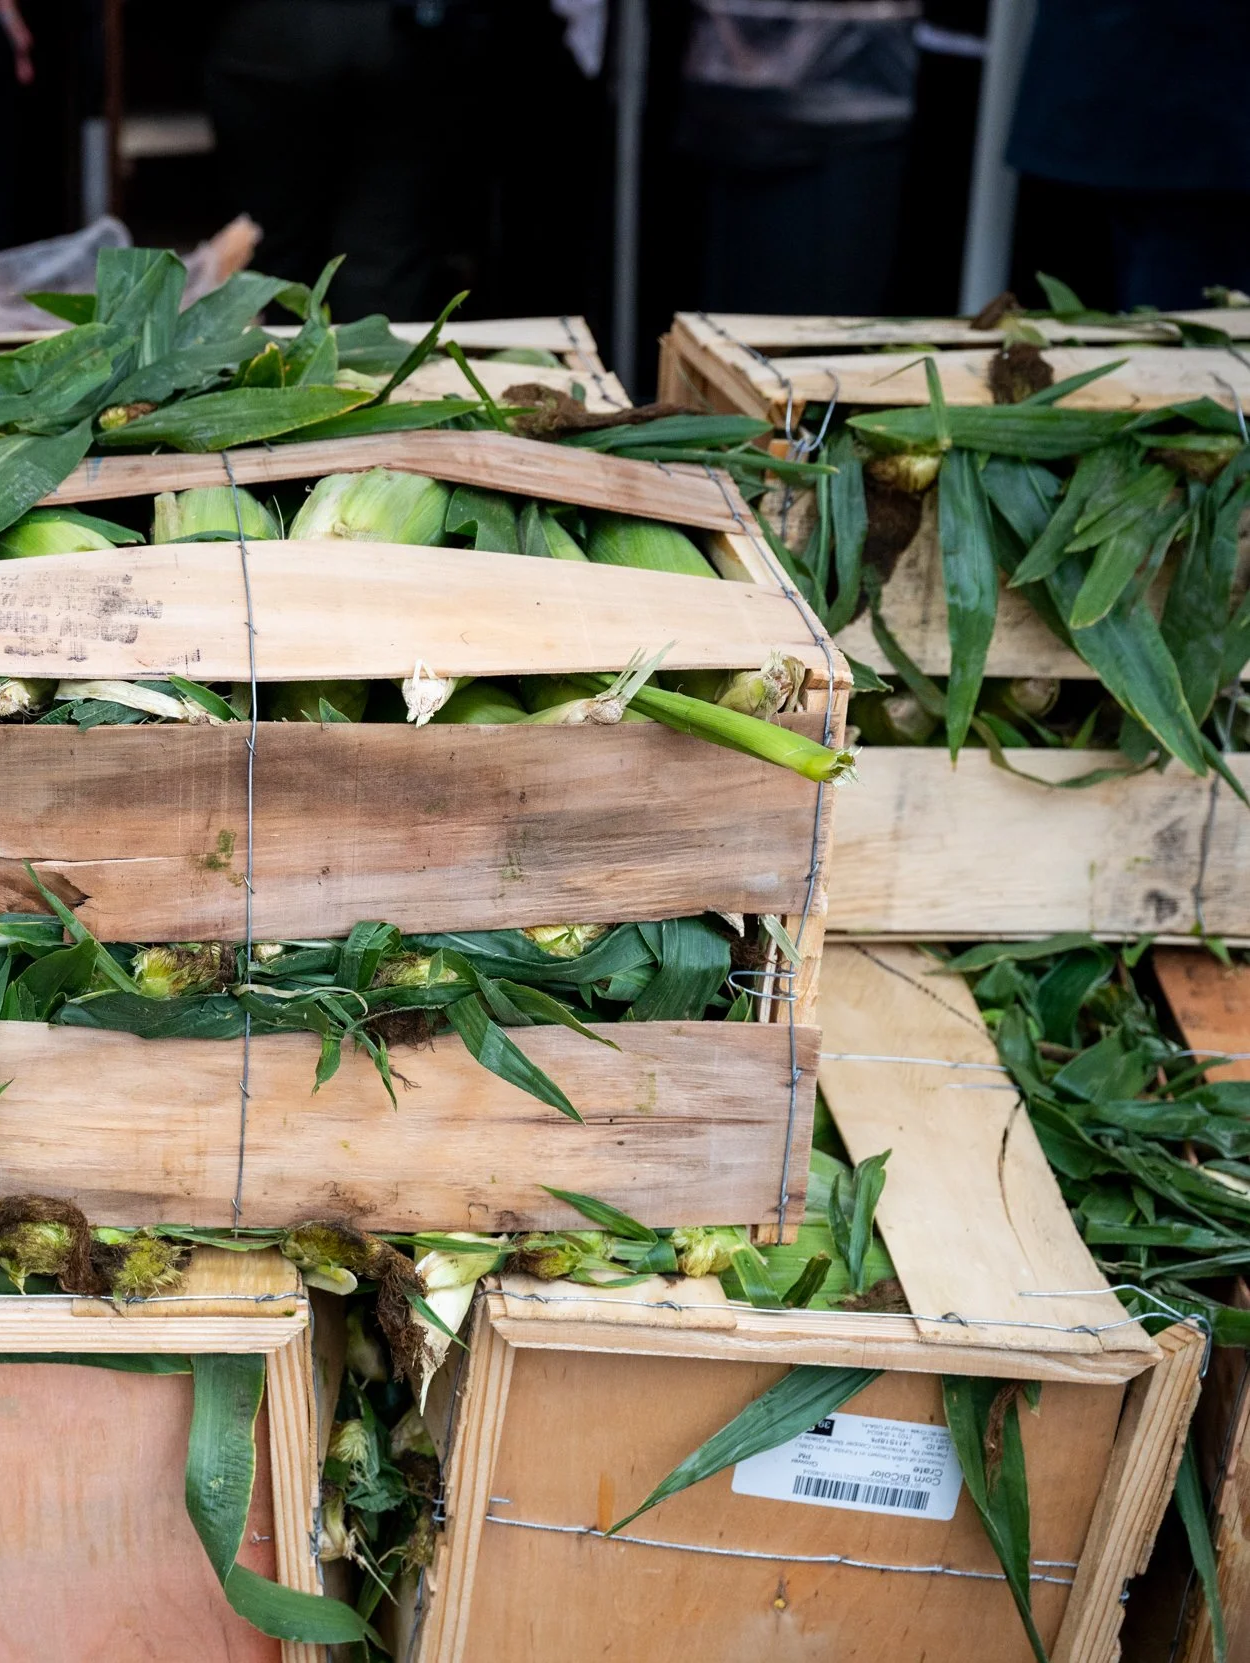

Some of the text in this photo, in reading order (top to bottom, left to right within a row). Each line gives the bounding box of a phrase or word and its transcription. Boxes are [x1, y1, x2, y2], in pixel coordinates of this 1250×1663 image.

[869, 1469, 941, 1485] Corn BiColor
[912, 1465, 943, 1476] Crate
